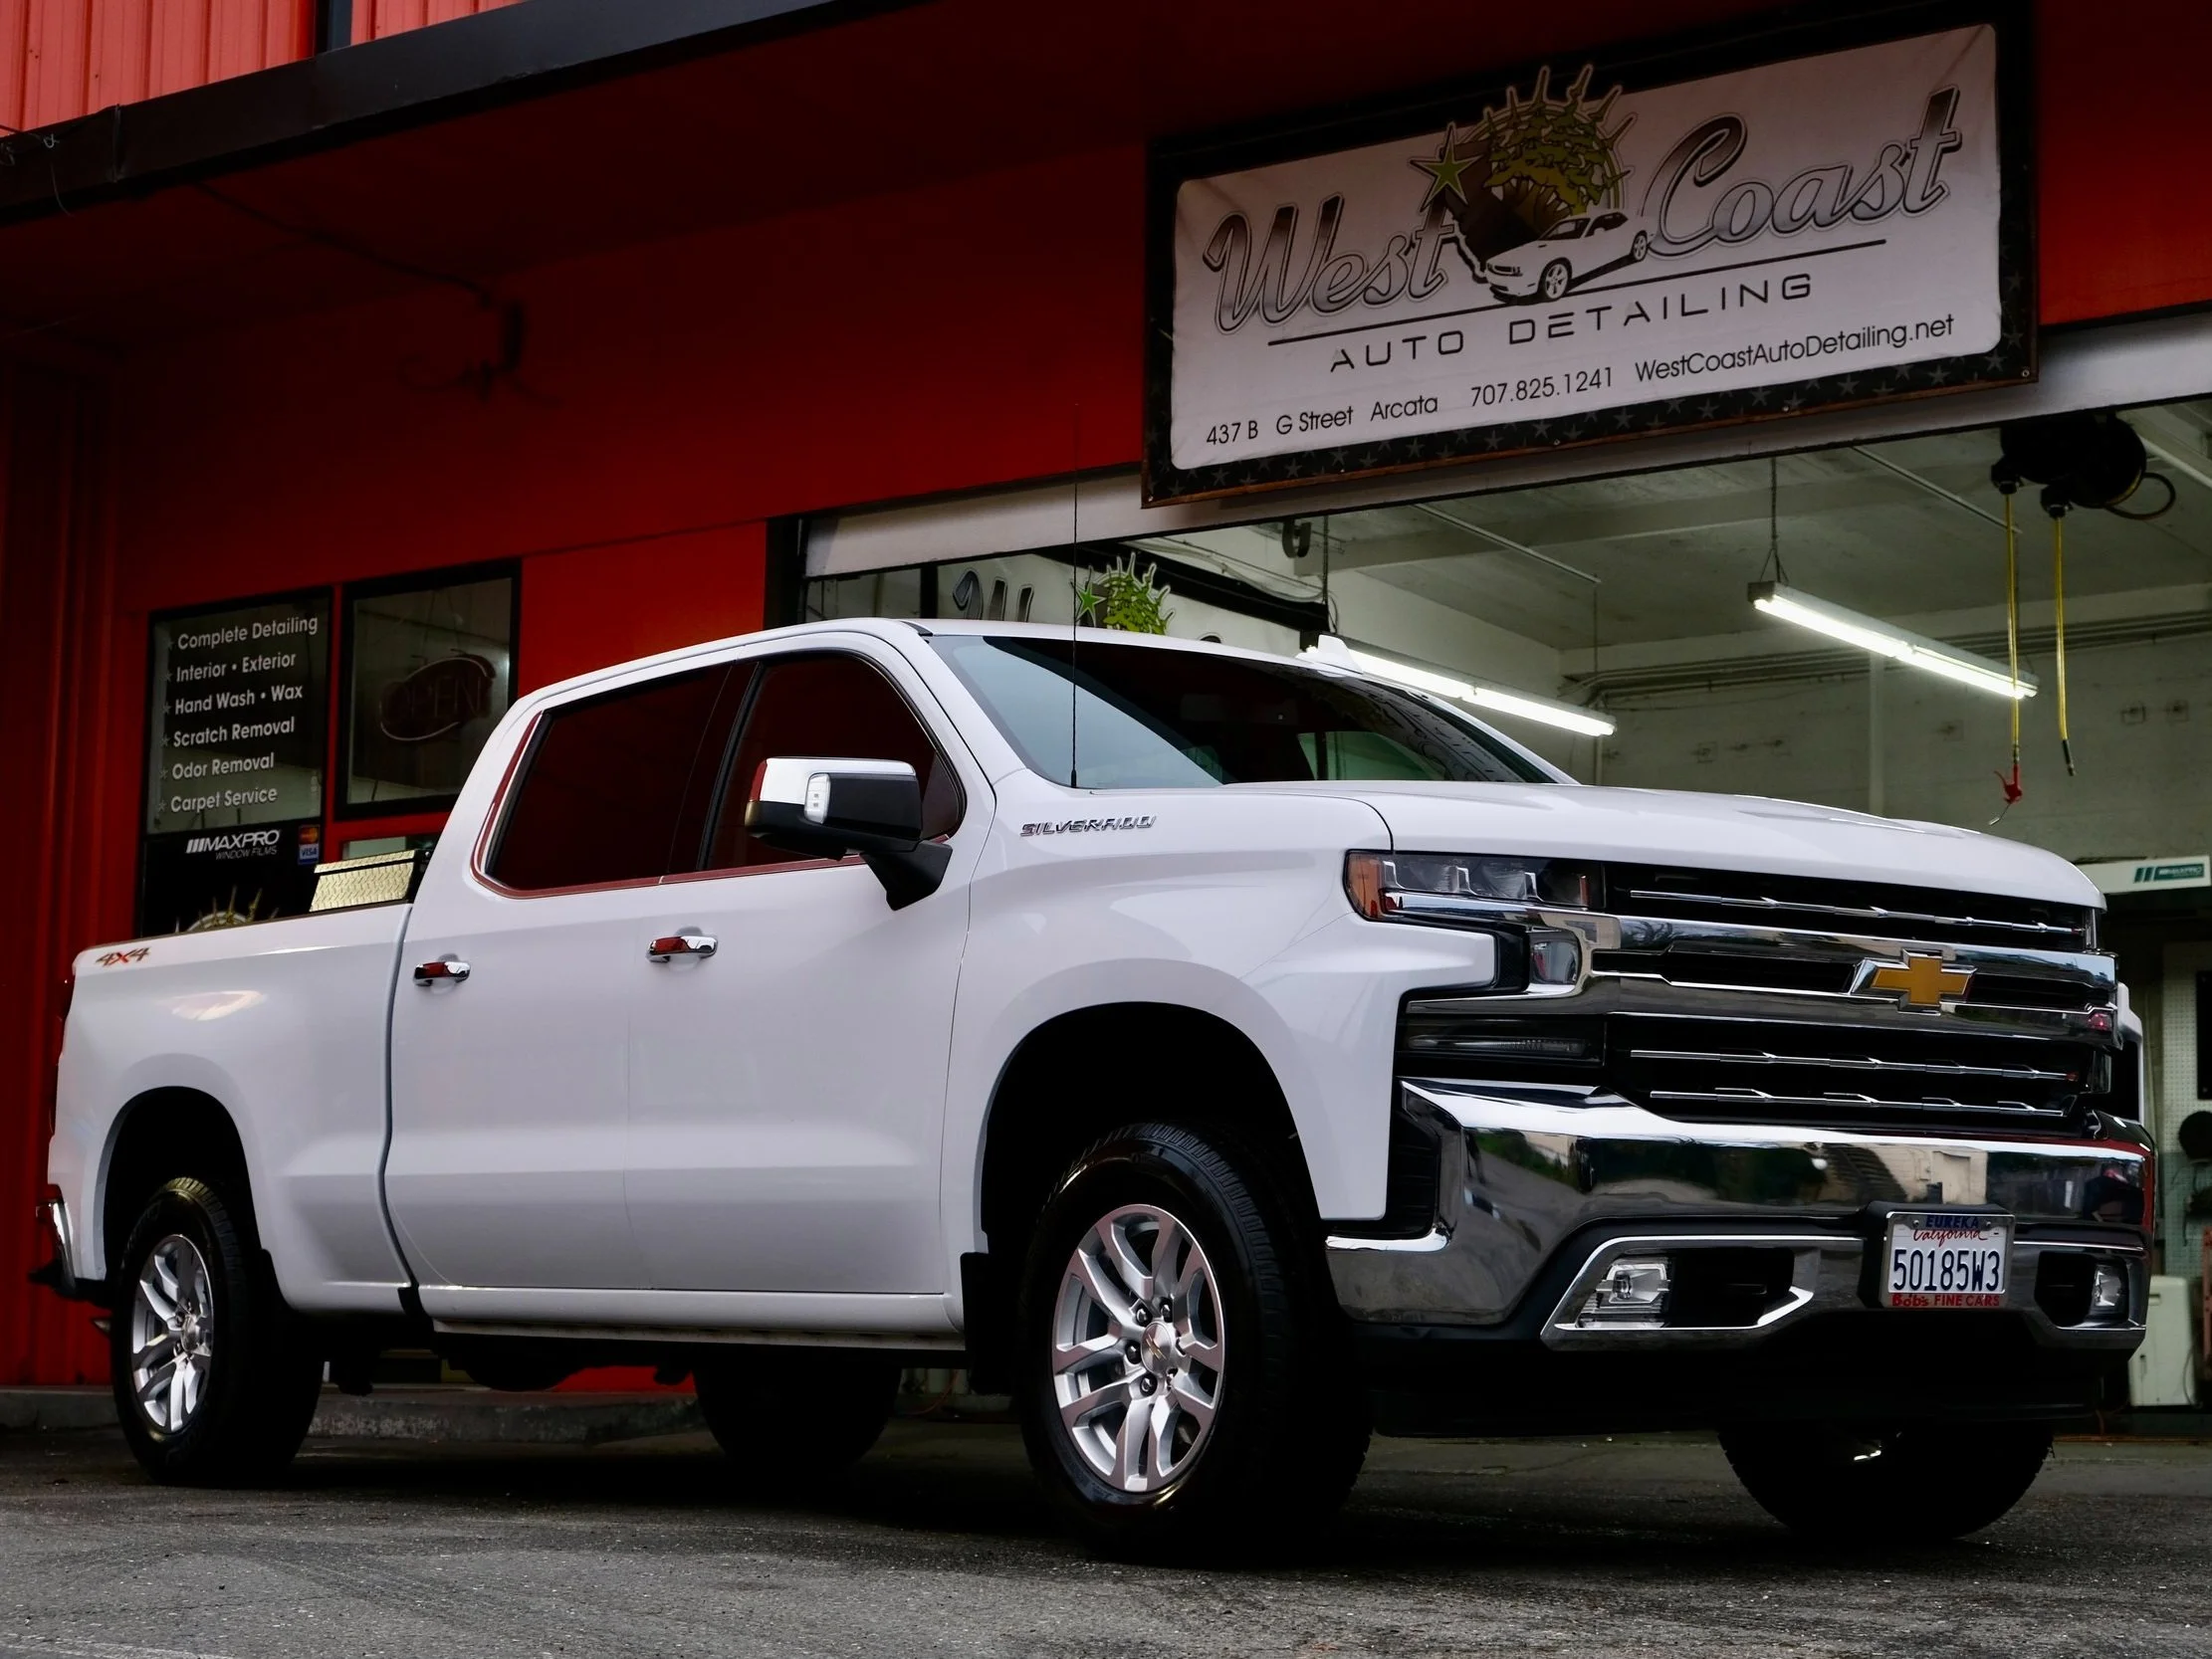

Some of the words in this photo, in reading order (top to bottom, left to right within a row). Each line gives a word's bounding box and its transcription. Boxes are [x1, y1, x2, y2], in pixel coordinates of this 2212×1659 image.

[1203, 189, 1459, 334] West
[1641, 85, 1963, 259] Coast
[1330, 329, 1464, 373] AUTO
[1508, 273, 1812, 344] DETAILING
[1206, 421, 1241, 446] 437
[1247, 420, 1259, 440] B
[1275, 414, 1292, 435] G
[1298, 405, 1354, 432] Street
[1370, 394, 1438, 422] Arcata
[1470, 365, 1613, 407] 707.825.1241
[1635, 312, 1955, 384] WestCoastAutoDetailing.net
[177, 625, 248, 650] Complete
[252, 616, 319, 640] Detailing
[176, 662, 227, 683] Interior
[242, 652, 297, 673] Exterior
[175, 695, 212, 715] Hand
[216, 689, 255, 710] Wash
[271, 684, 303, 703] Wax
[173, 726, 228, 747] Scratch
[231, 716, 296, 740] Removal
[172, 761, 207, 780] Odor
[211, 751, 275, 775] Removal
[170, 791, 221, 813] Carpet
[224, 786, 278, 807] Service
[203, 830, 281, 852] MAXPRO
[1019, 815, 1157, 837] SILVERADO
[216, 848, 250, 860] WINDOW
[251, 846, 278, 857] FILMS
[1925, 1215, 1979, 1228] EUREKA
[1912, 1229, 1988, 1247] California
[1893, 1249, 2000, 1292] 50185W3
[1892, 1294, 1929, 1307] Bob's
[1934, 1295, 1962, 1306] FINE
[1965, 1295, 2000, 1307] CARS
